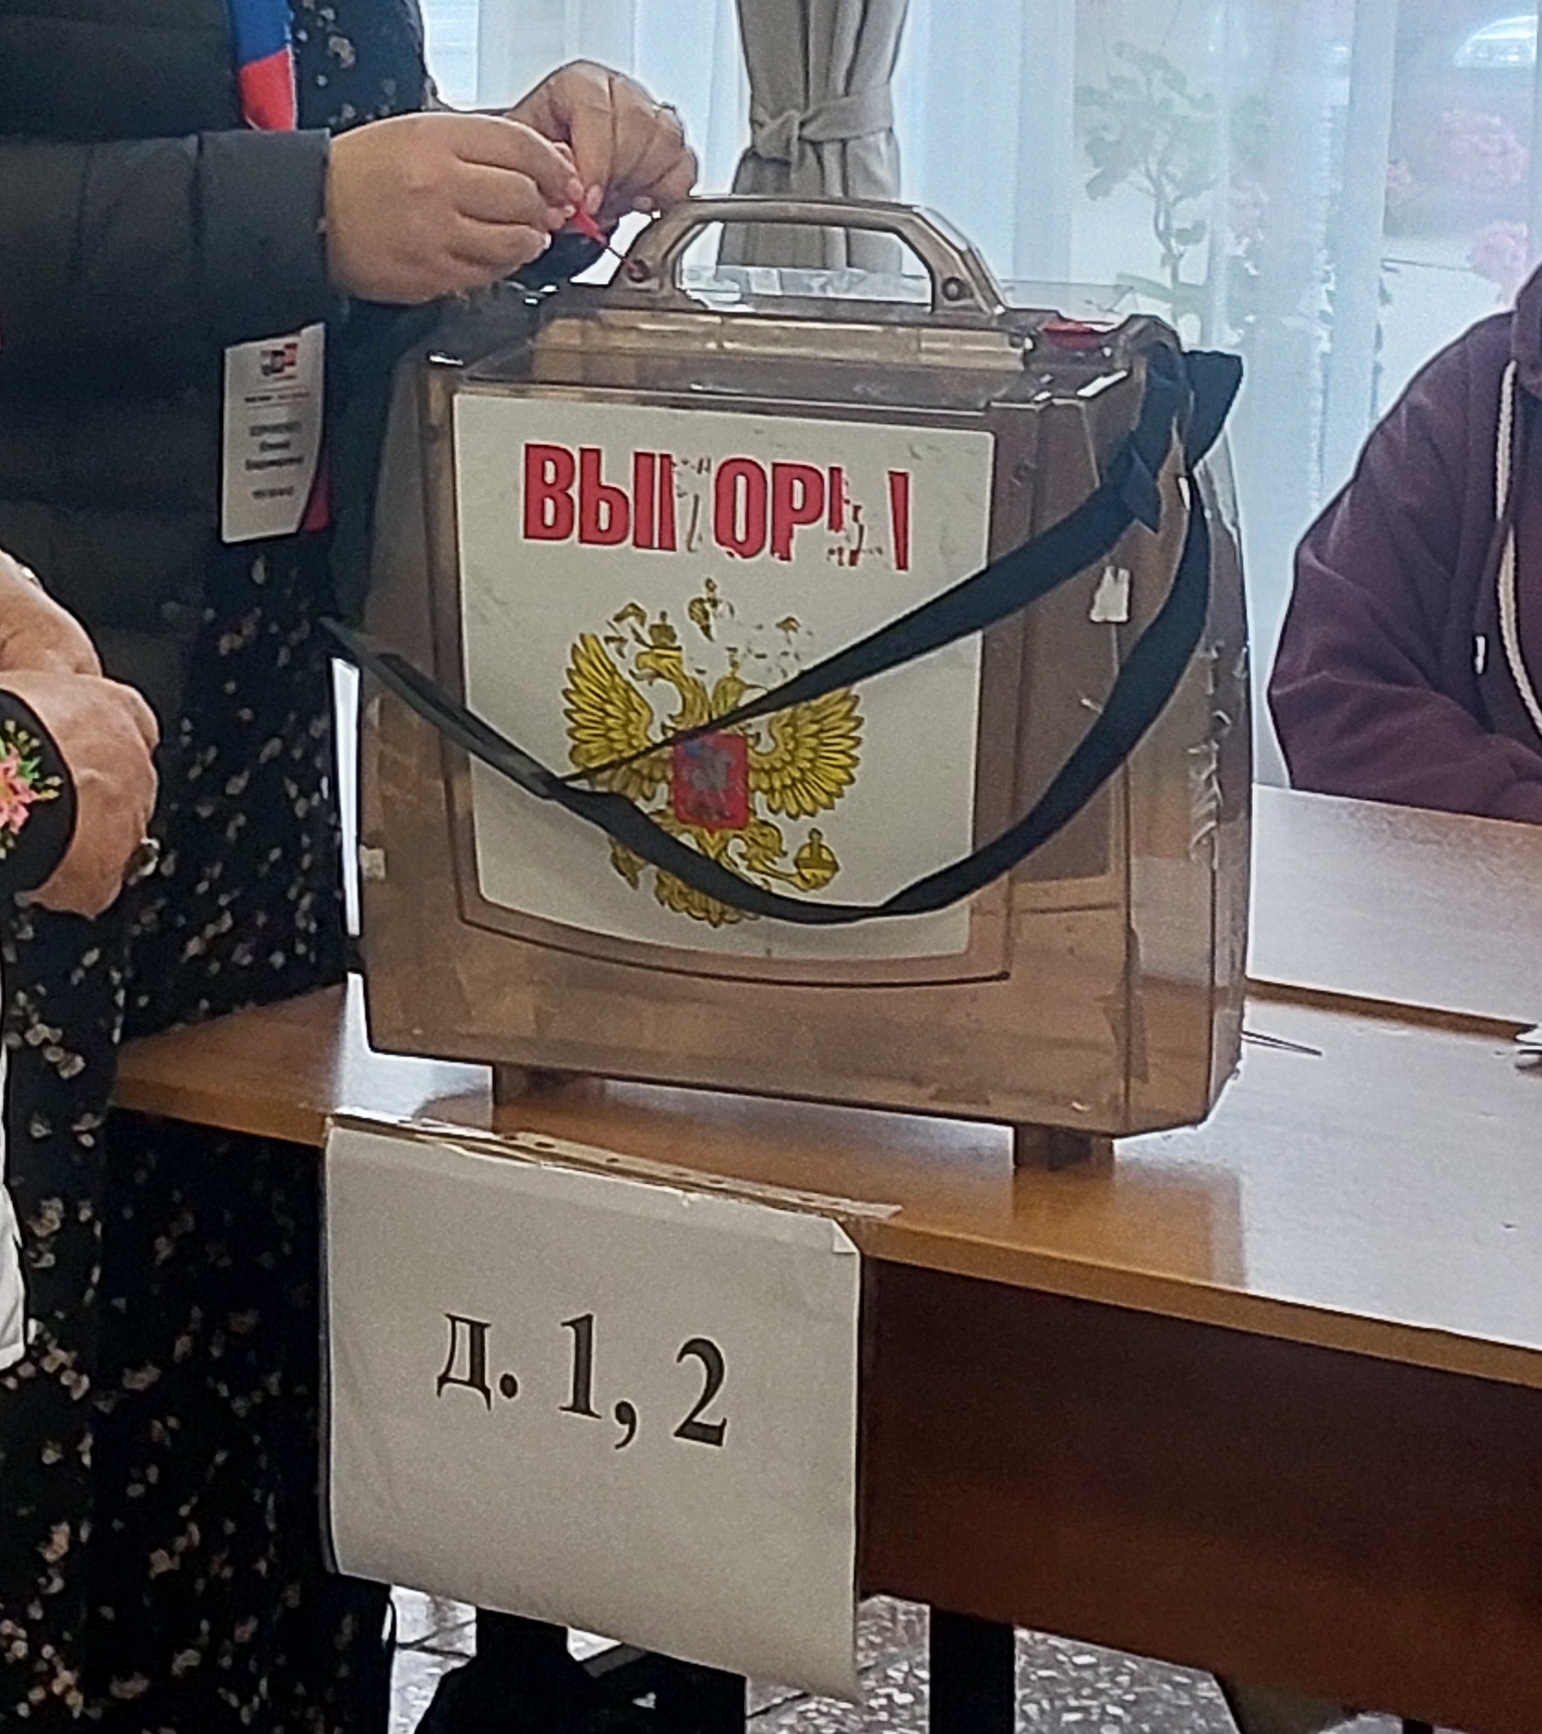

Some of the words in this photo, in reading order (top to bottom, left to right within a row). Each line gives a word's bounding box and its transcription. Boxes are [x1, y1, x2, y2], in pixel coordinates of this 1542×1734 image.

[436, 1312, 519, 1412] д.
[558, 1312, 637, 1450] 1,
[672, 1336, 728, 1447] 2
